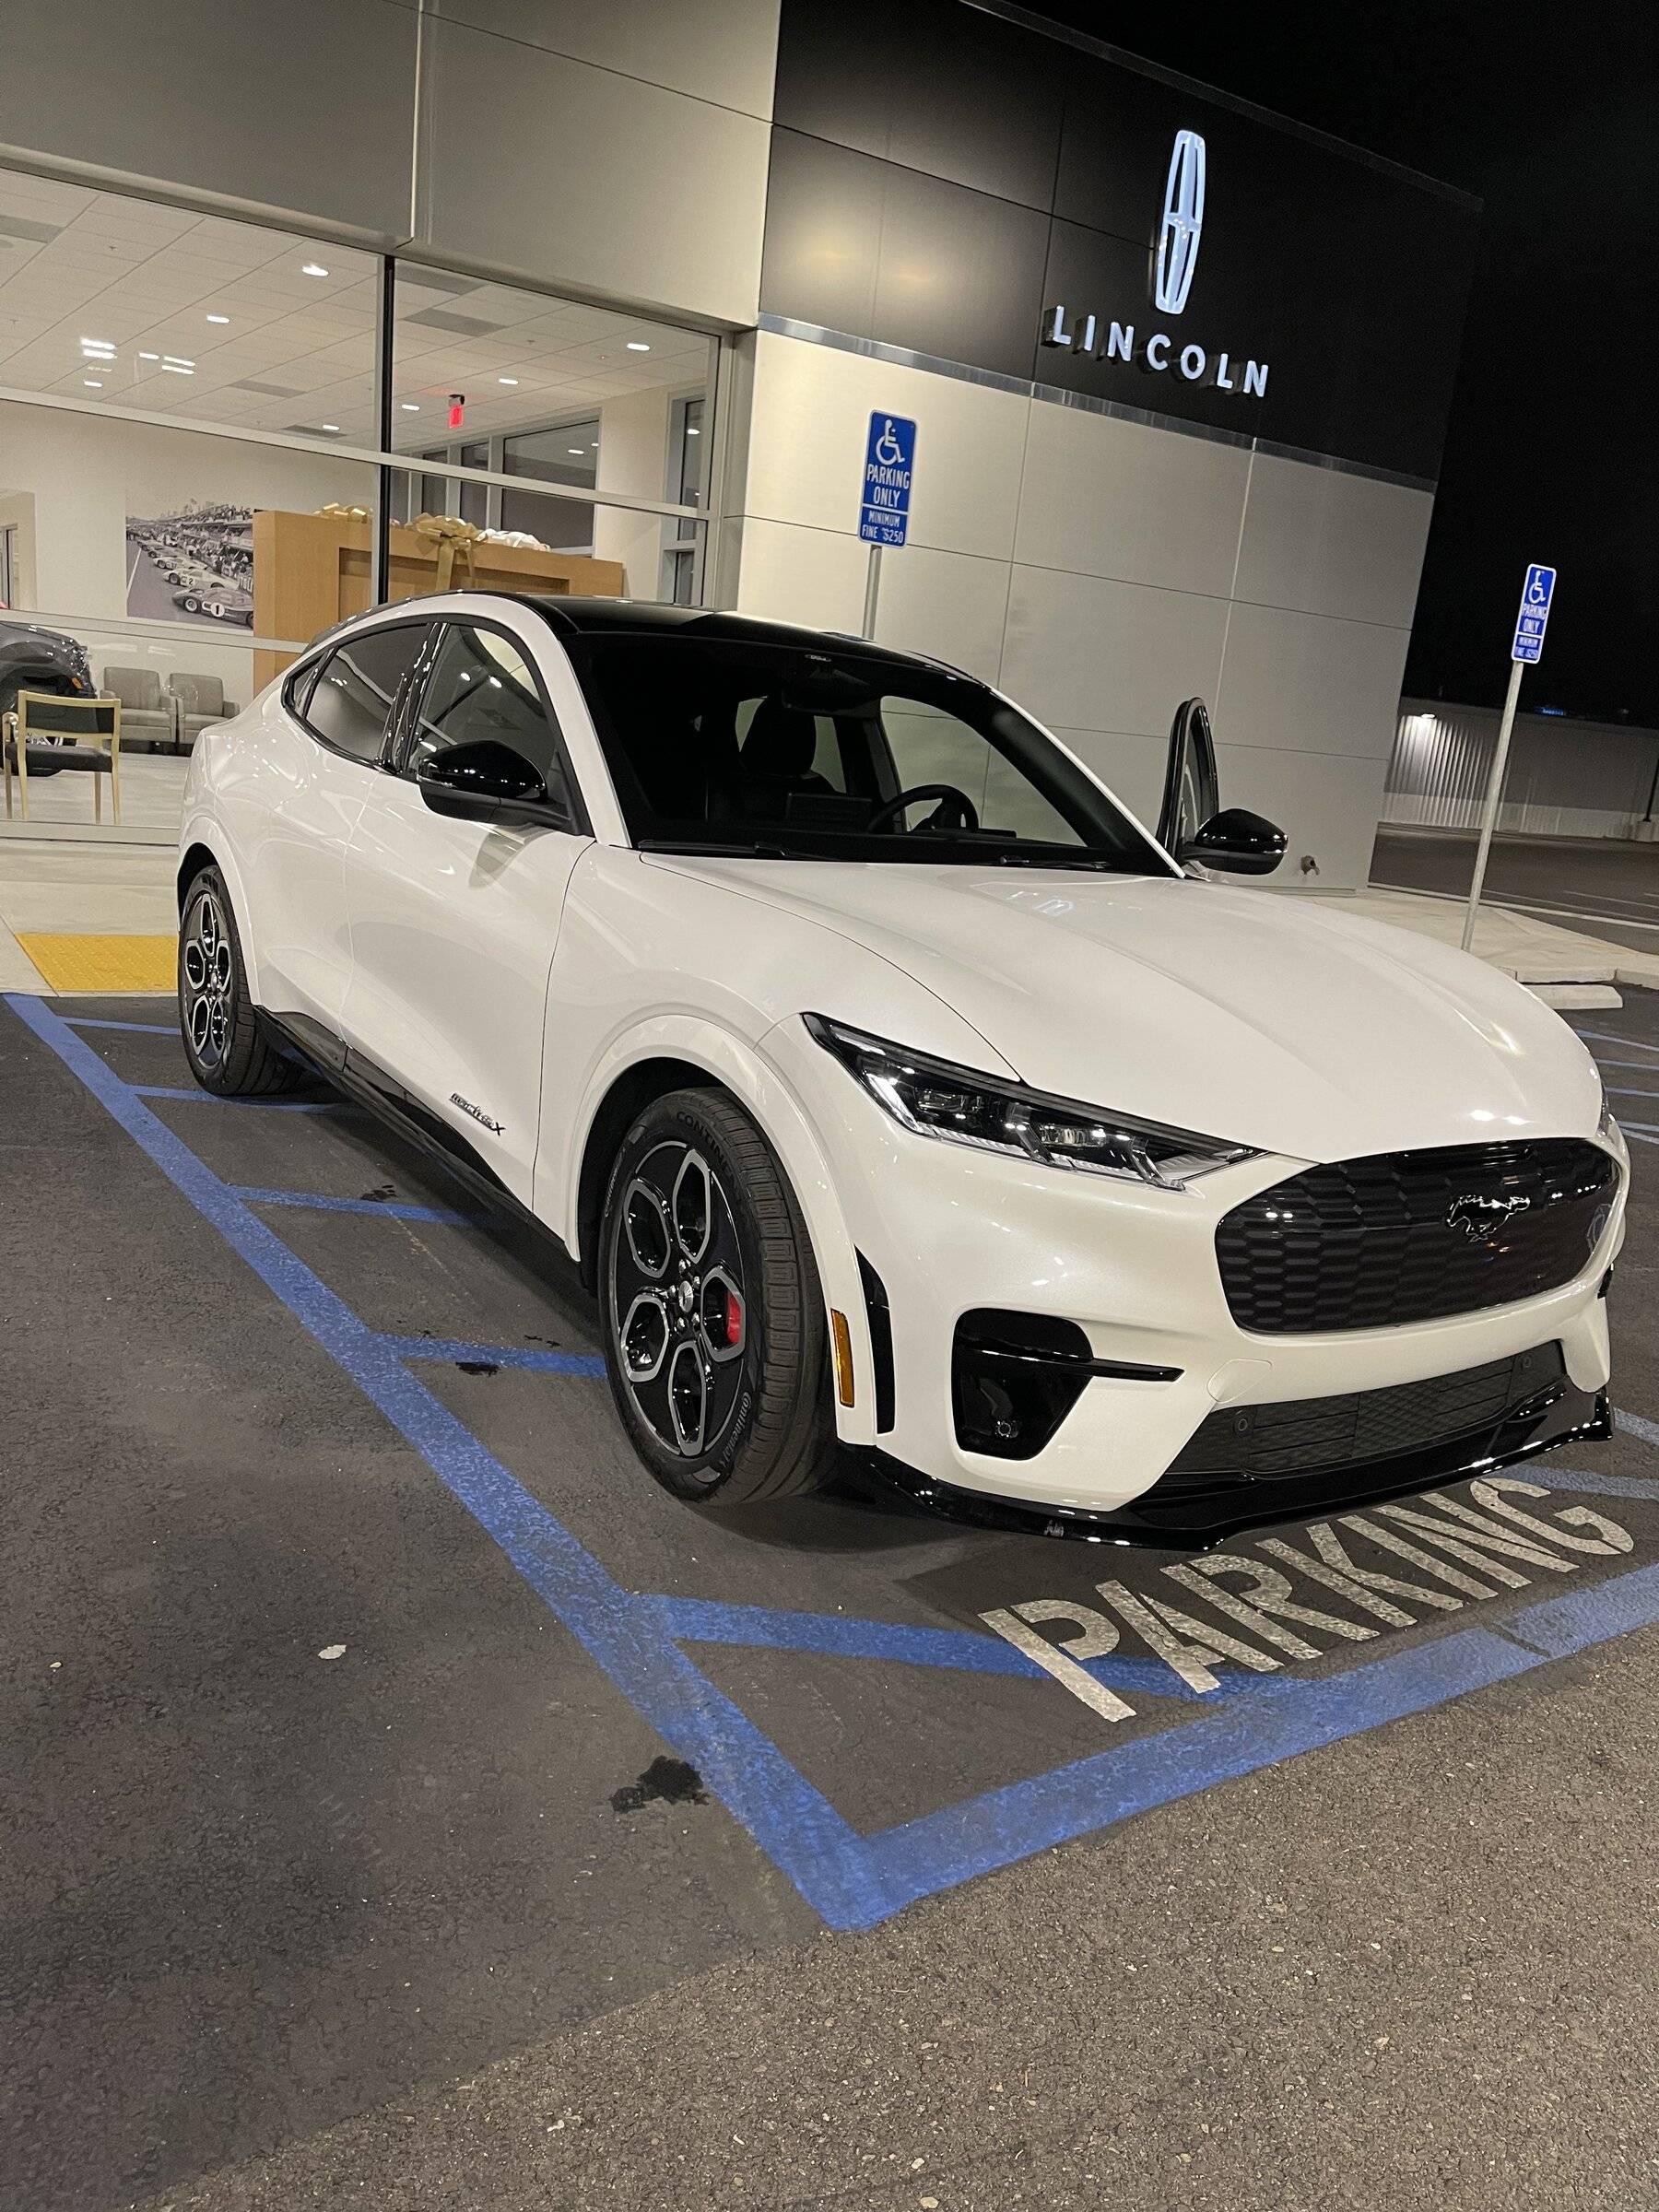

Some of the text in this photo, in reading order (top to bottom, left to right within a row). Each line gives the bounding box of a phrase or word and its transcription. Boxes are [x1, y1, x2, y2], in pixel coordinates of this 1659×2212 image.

[1052, 305, 1269, 398] LINCOLN
[866, 464, 911, 489] PARKING
[874, 487, 900, 508] ONLY
[868, 511, 900, 527] MINIMUM
[861, 524, 878, 539] FINE
[978, 1478, 1635, 1723] PARKING
